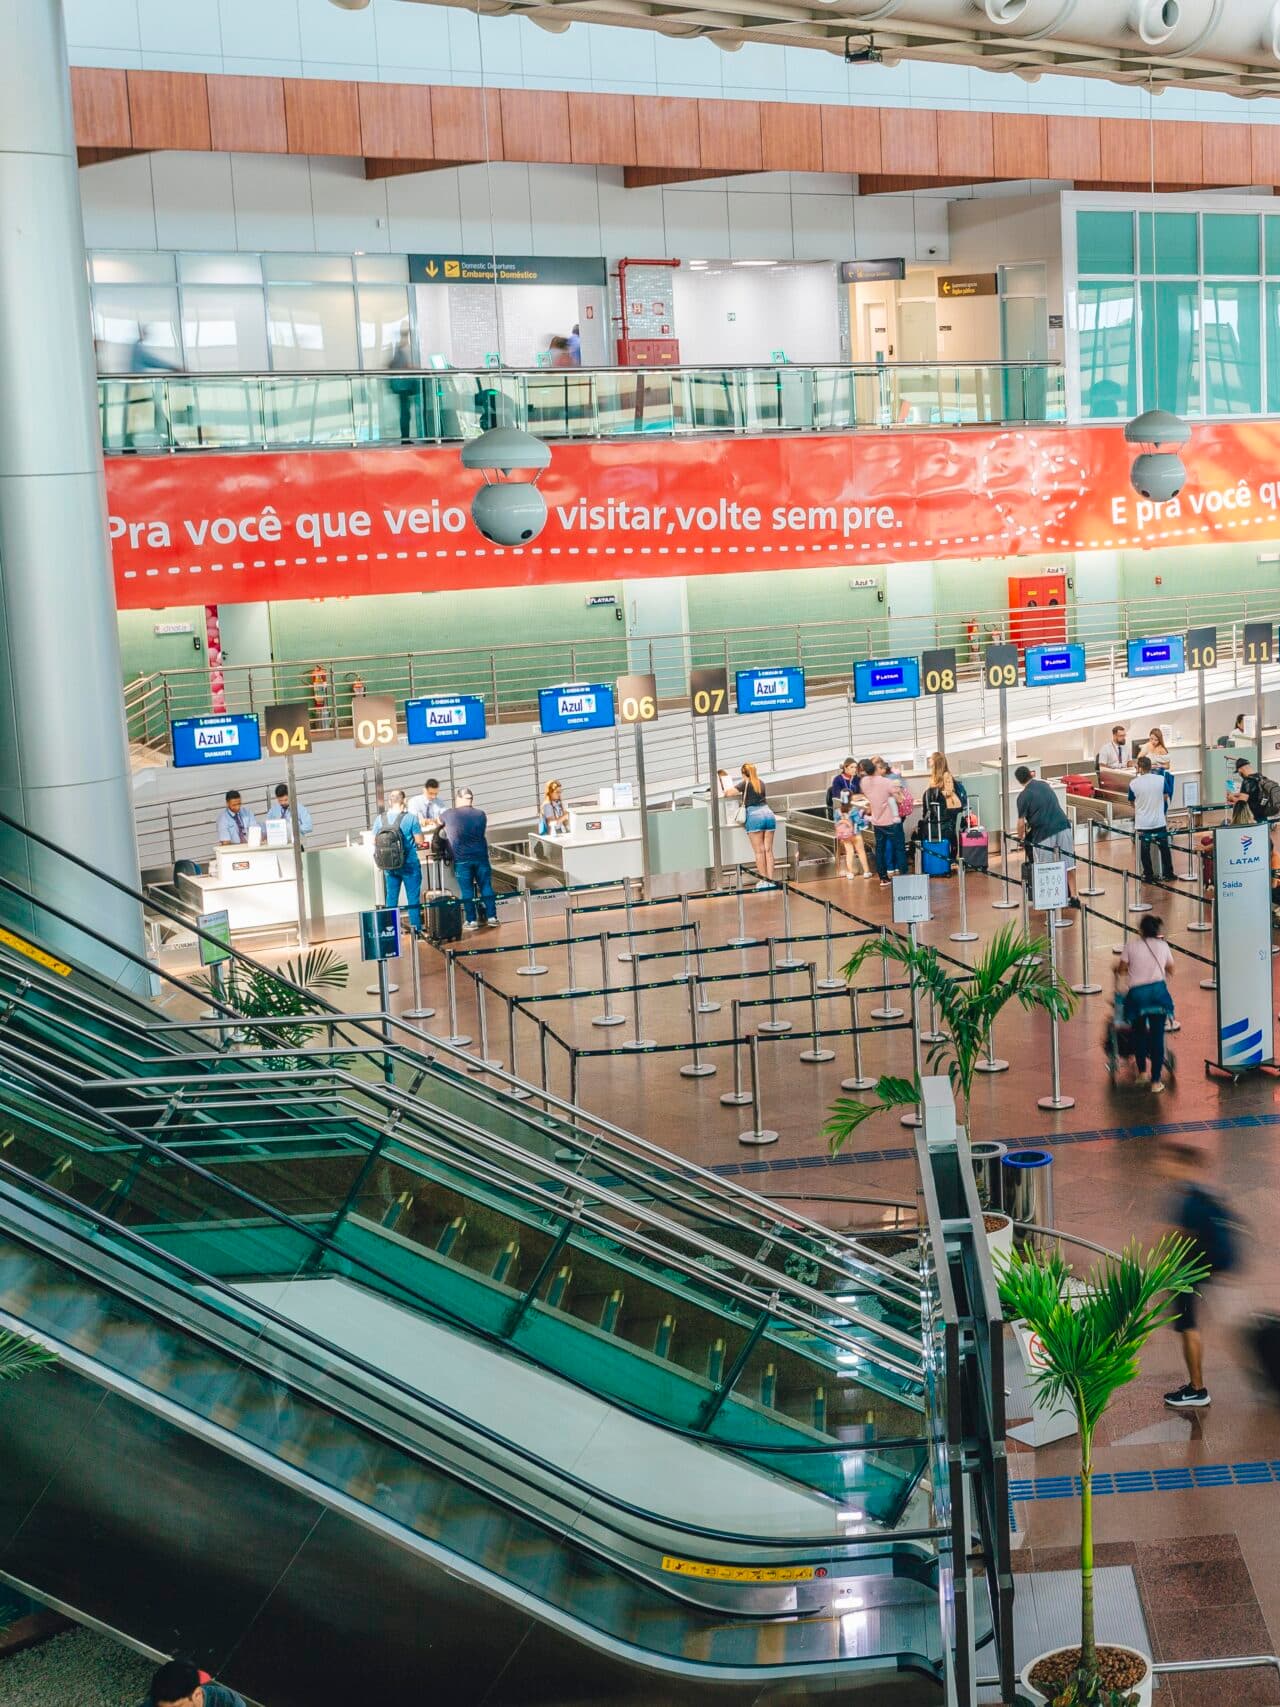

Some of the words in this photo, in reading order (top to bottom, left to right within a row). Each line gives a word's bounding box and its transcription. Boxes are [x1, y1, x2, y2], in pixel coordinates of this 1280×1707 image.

[500, 270, 537, 279] Doméstico
[1111, 497, 1127, 524] E
[1136, 498, 1181, 530] pra
[1189, 480, 1251, 514] você
[108, 517, 170, 549] Pra
[184, 506, 282, 545] você
[295, 509, 371, 548] que
[383, 498, 466, 535] veio
[772, 504, 904, 538] sempre.
[1191, 646, 1216, 668] 10
[1247, 641, 1270, 663] 11
[925, 669, 955, 692] 08
[988, 664, 1017, 687] 09
[756, 681, 777, 695] Azul
[561, 698, 583, 714] Azul
[622, 696, 656, 721] 06
[694, 689, 725, 713] 07
[429, 710, 452, 725] Azul
[198, 730, 224, 746] Azul
[269, 727, 309, 754] 04
[356, 719, 394, 745] 05
[1229, 856, 1260, 865] LATAM
[368, 930, 396, 939] TAzul
